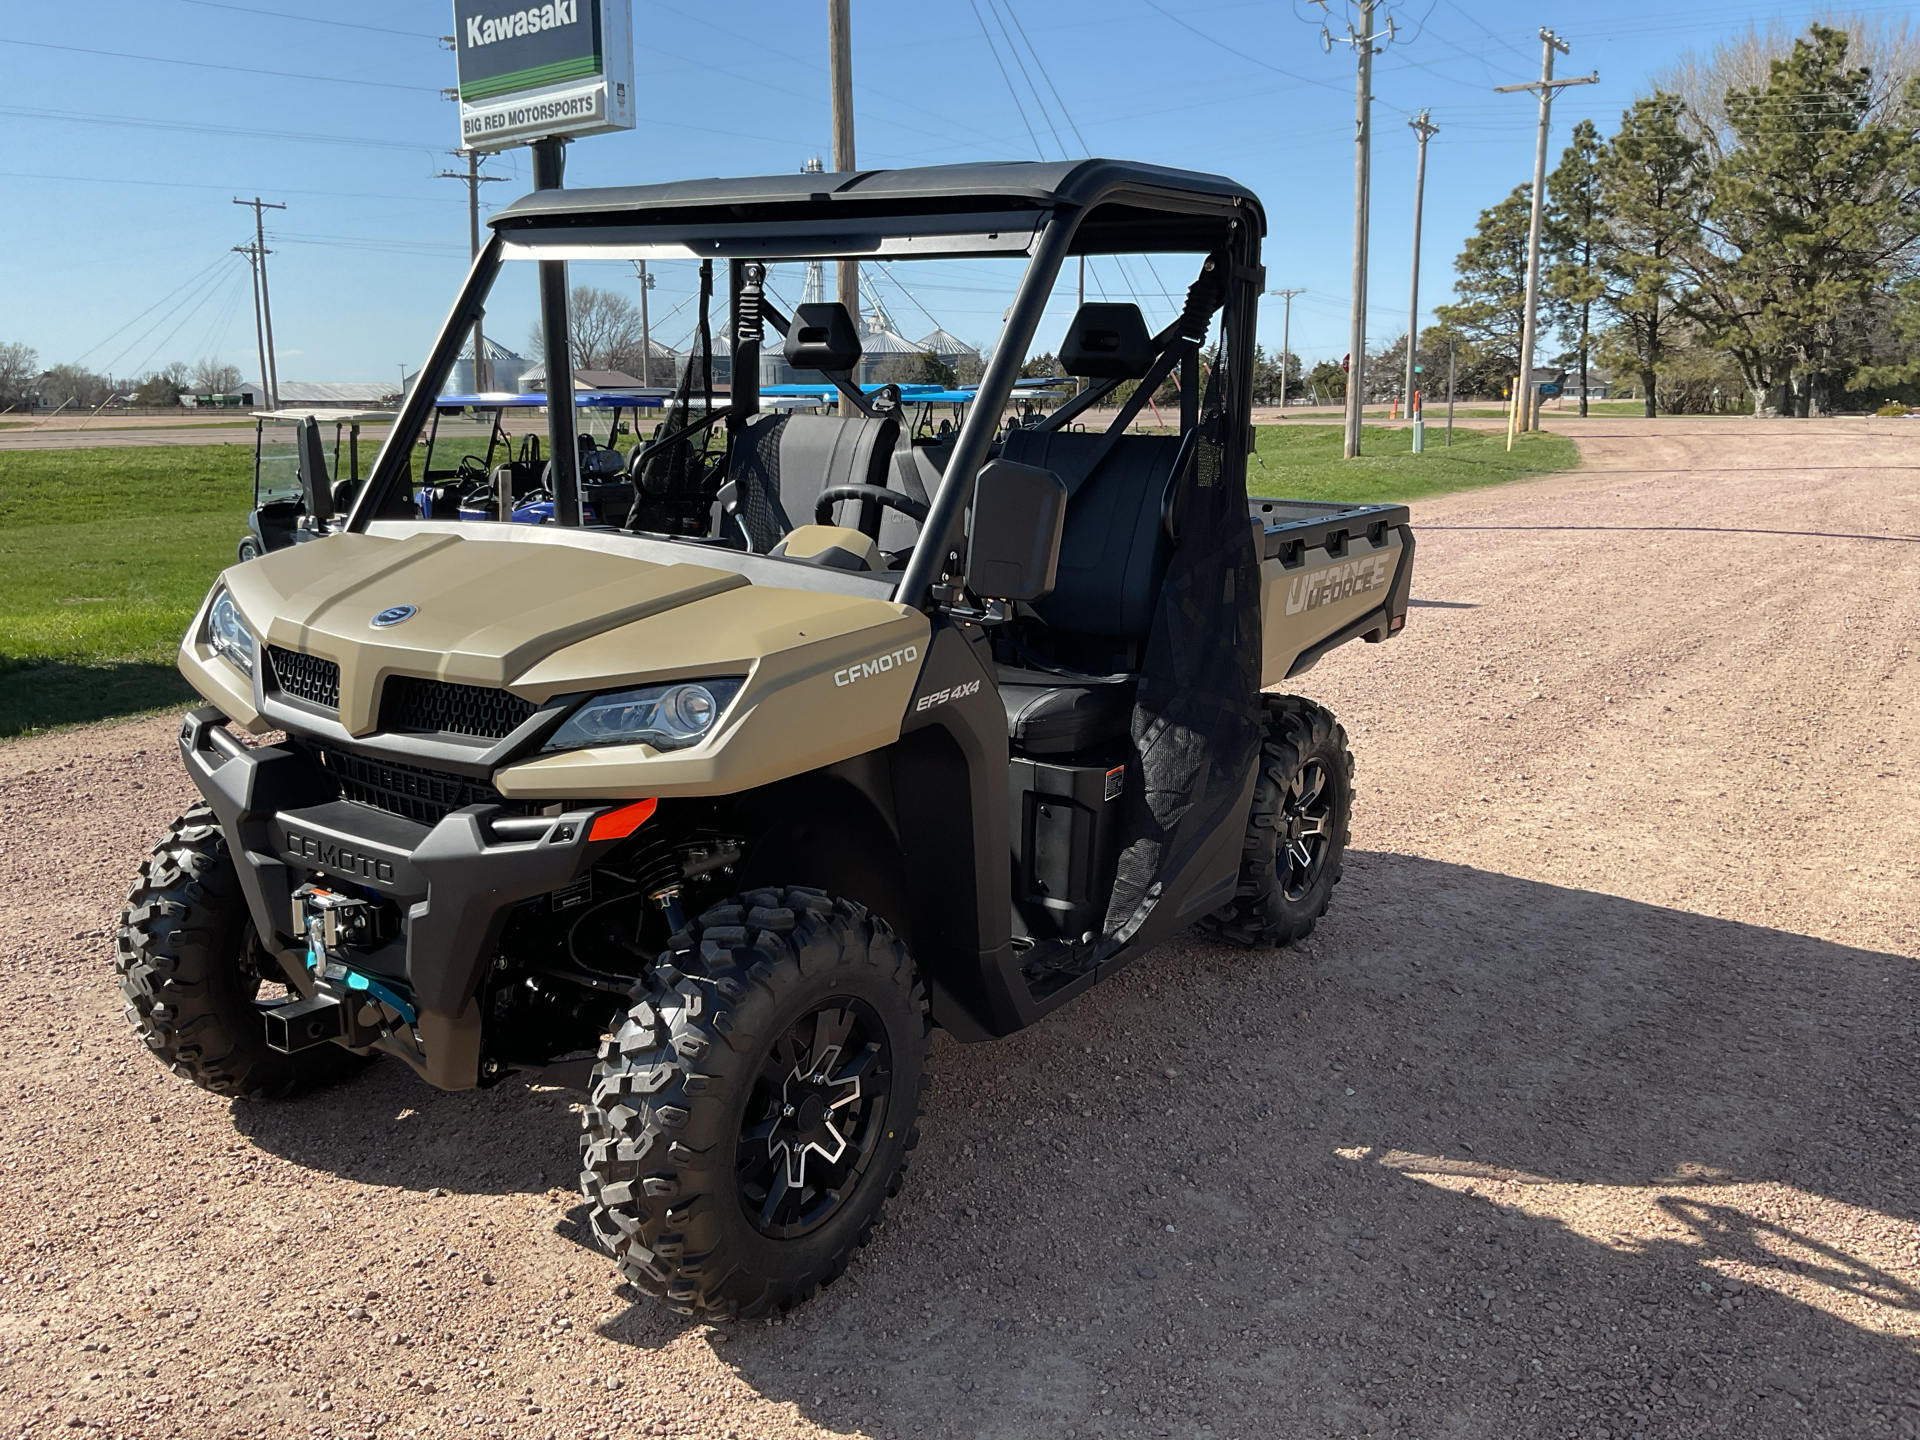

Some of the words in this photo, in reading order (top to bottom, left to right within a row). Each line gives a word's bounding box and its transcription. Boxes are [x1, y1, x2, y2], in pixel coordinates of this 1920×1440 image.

[467, 0, 577, 48] Kawasaki
[464, 118, 482, 134] BIG
[485, 113, 505, 130] RED
[509, 96, 593, 126] MOTORSPORTS
[1307, 571, 1375, 611] UFORCE
[834, 645, 918, 687] CFMOTO
[916, 688, 951, 712] EPS
[287, 831, 394, 885] CFMOTO
